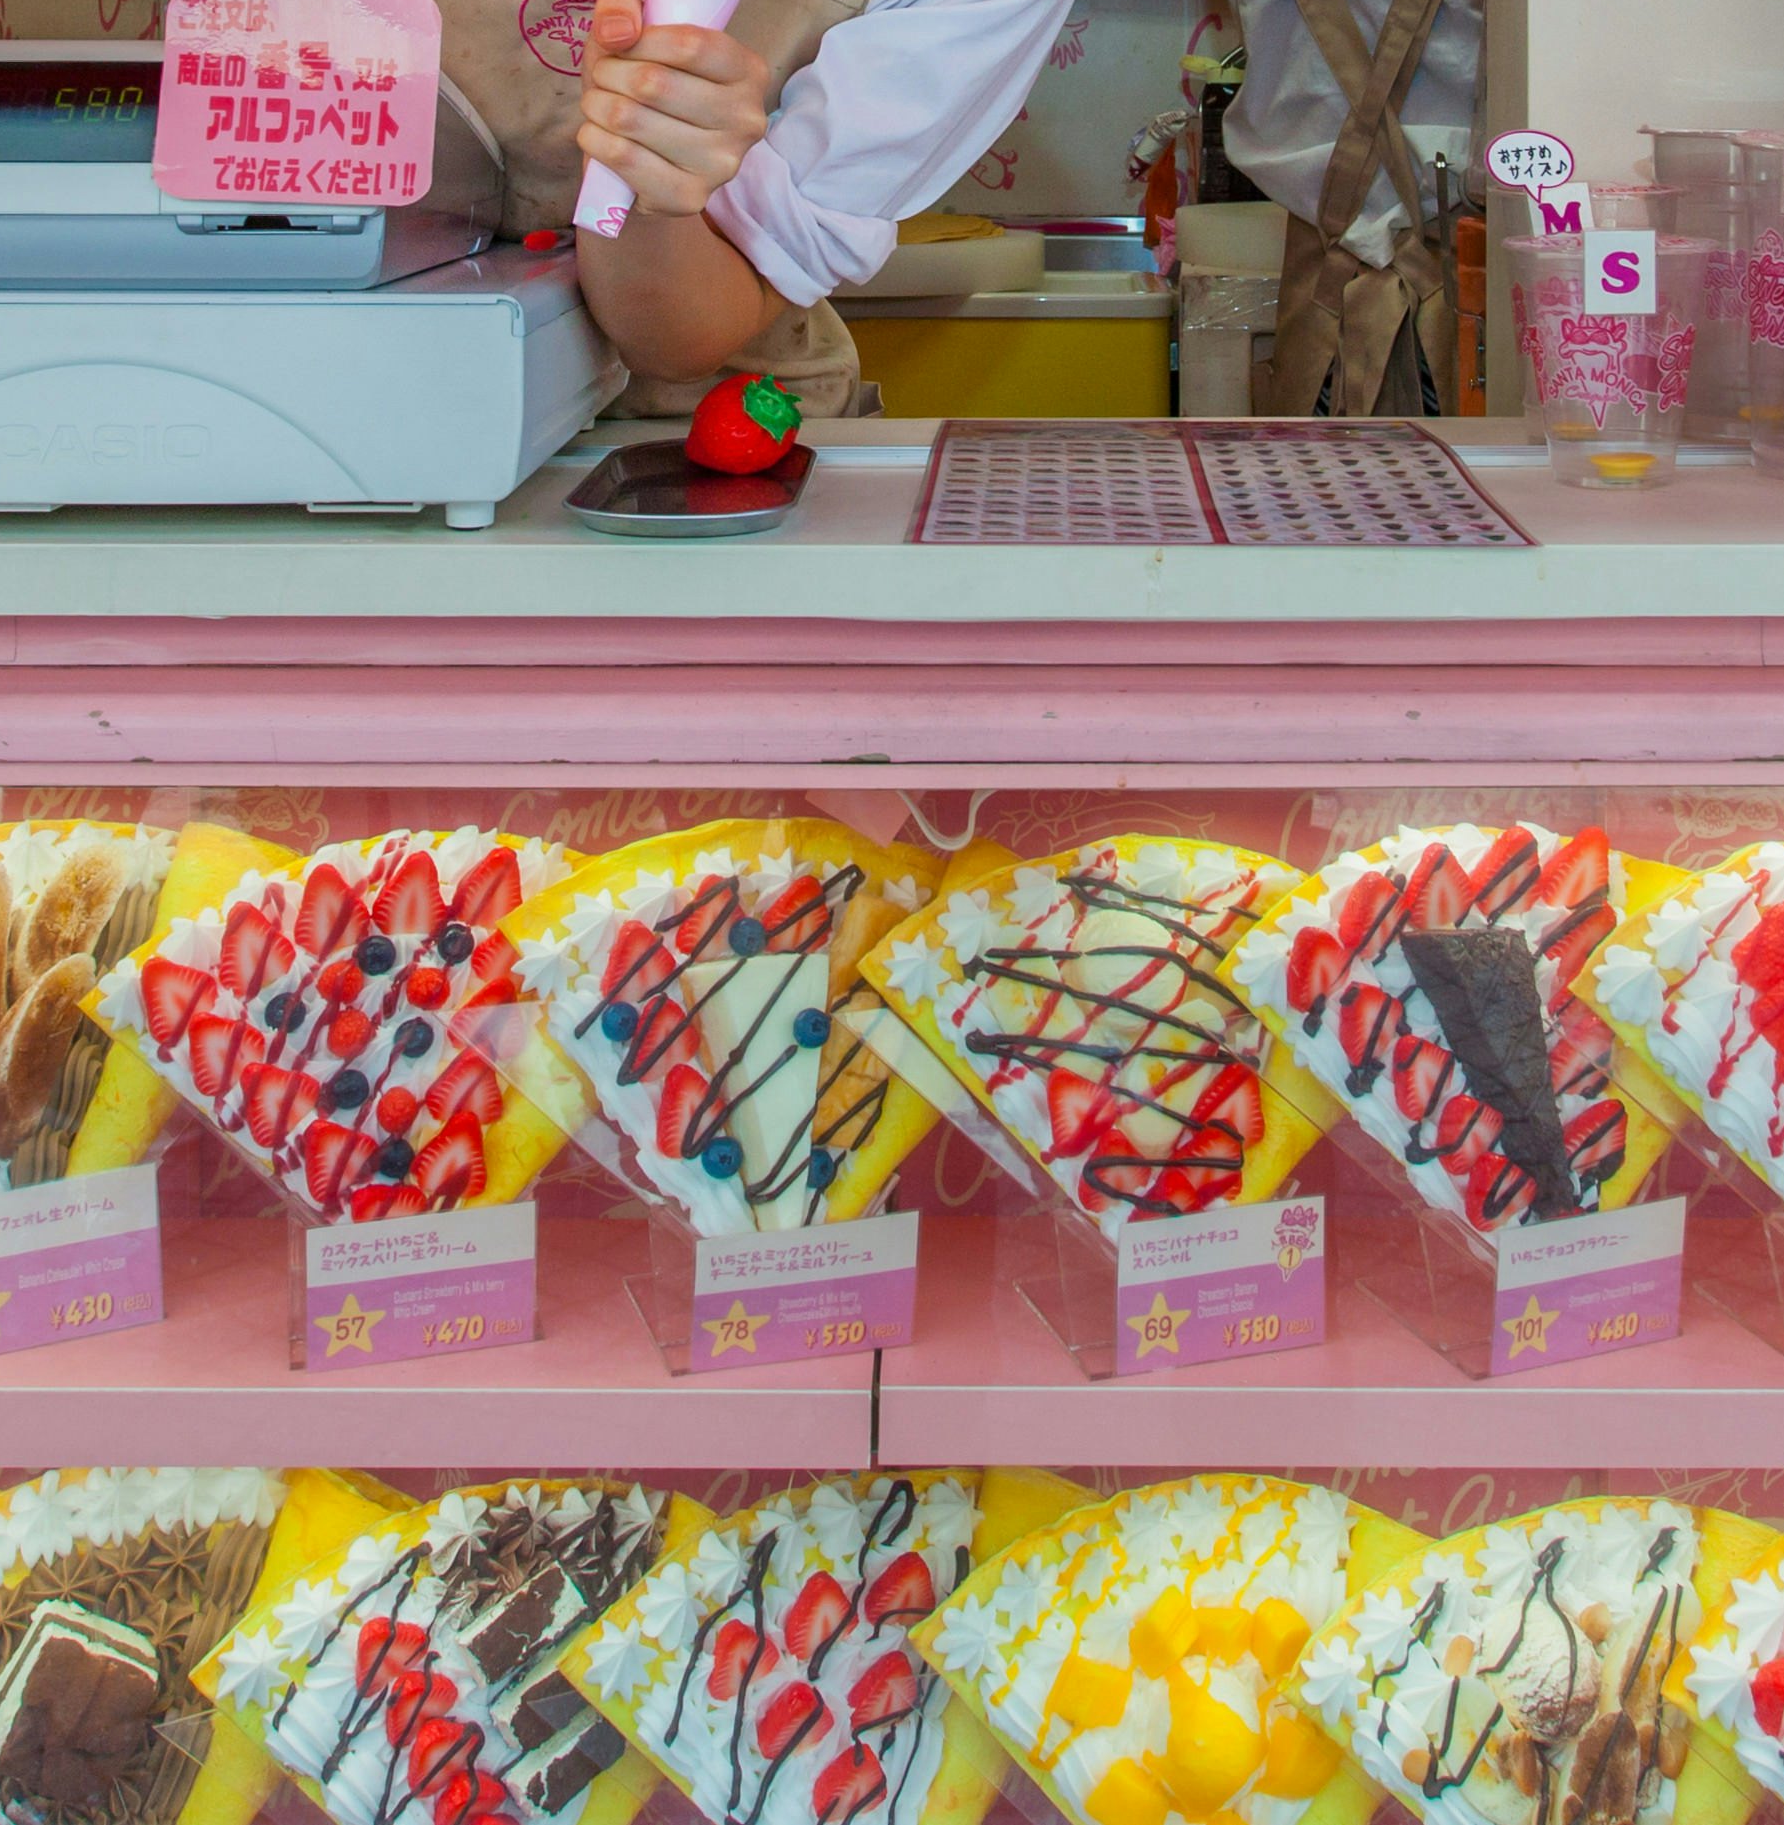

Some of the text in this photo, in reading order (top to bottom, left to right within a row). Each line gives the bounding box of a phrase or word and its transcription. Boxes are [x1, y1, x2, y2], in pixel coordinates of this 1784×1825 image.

[528, 16, 575, 38] SANTA
[53, 87, 143, 123] 580
[207, 96, 399, 146] アルファベット
[1498, 144, 1551, 164] おすすめ
[1538, 201, 1582, 234] M
[1601, 251, 1640, 294] S
[1549, 366, 1647, 415] SANTA MONICA
[321, 1242, 477, 1271] ミックスベリー生クリーム
[1133, 1230, 1239, 1255] いちごバナナチョコ
[1133, 1250, 1191, 1270] スペシャル
[50, 1292, 113, 1330] ¥430
[335, 1316, 366, 1341] 57
[423, 1314, 485, 1347] ¥470
[721, 1320, 749, 1342] 78
[805, 1321, 865, 1350] ¥550
[1145, 1316, 1172, 1342] 69
[1223, 1315, 1280, 1347] ¥580
[1515, 1316, 1543, 1343] 101
[1587, 1312, 1639, 1346] ¥480
